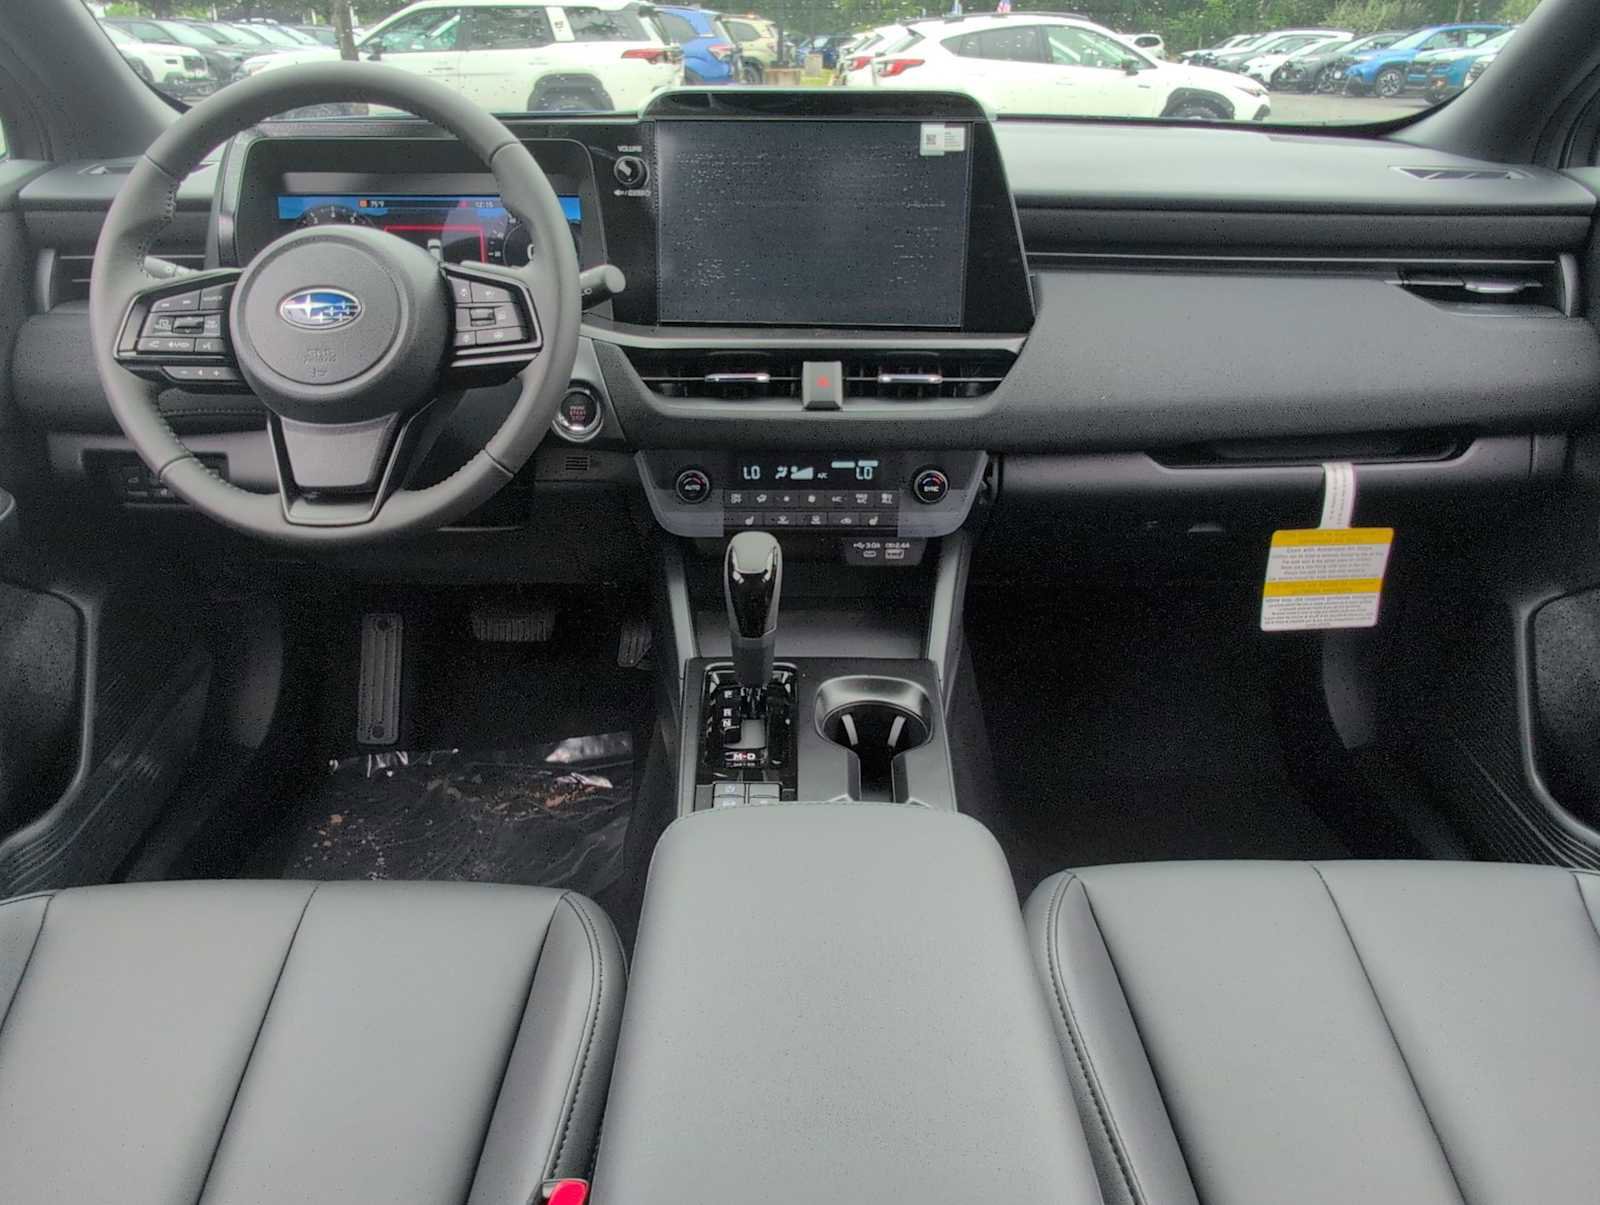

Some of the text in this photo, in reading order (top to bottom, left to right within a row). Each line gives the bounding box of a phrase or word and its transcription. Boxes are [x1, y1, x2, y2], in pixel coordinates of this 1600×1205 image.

[743, 465, 761, 480] LO
[855, 466, 873, 480] LO
[723, 709, 732, 717] R
[722, 718, 731, 726] N
